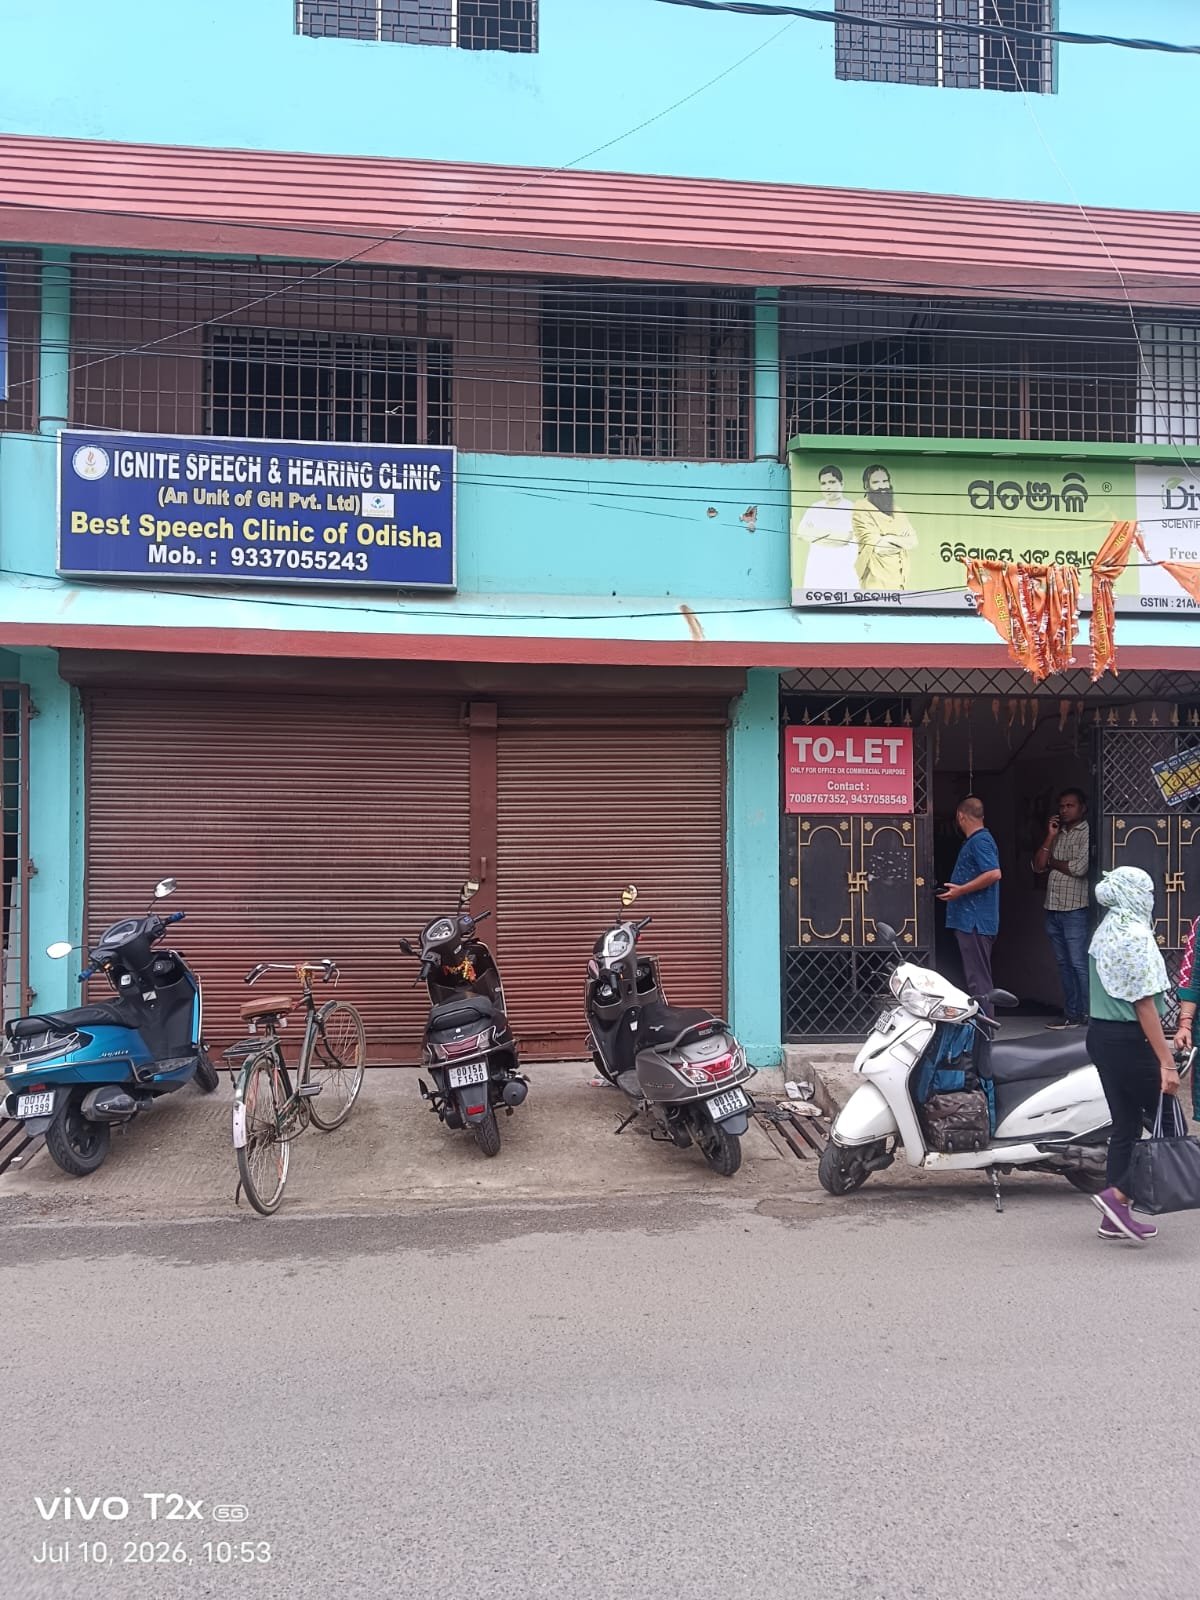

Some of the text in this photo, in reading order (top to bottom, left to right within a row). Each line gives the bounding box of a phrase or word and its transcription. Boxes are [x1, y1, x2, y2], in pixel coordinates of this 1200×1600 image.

[114, 450, 180, 480] IGNITE
[186, 454, 262, 483] SPEECH
[268, 458, 282, 484] &
[288, 458, 373, 488] HEARING
[378, 462, 442, 492] CLINIC
[158, 486, 188, 507] (An
[194, 488, 230, 505] Unit
[234, 490, 252, 506] of
[257, 490, 284, 508] GH
[288, 492, 322, 510] Pvt.
[327, 494, 360, 516] Ltd)
[71, 511, 442, 548] Best Speech Clinic of Odisha
[148, 544, 202, 564] Mob.
[230, 548, 368, 571] 9337055243
[1169, 546, 1198, 560] Free
[1140, 597, 1168, 608] GSTIN
[792, 737, 904, 764] TO-LET
[790, 794, 907, 804] 7008767352, 9437058548
[828, 781, 864, 790] Contact
